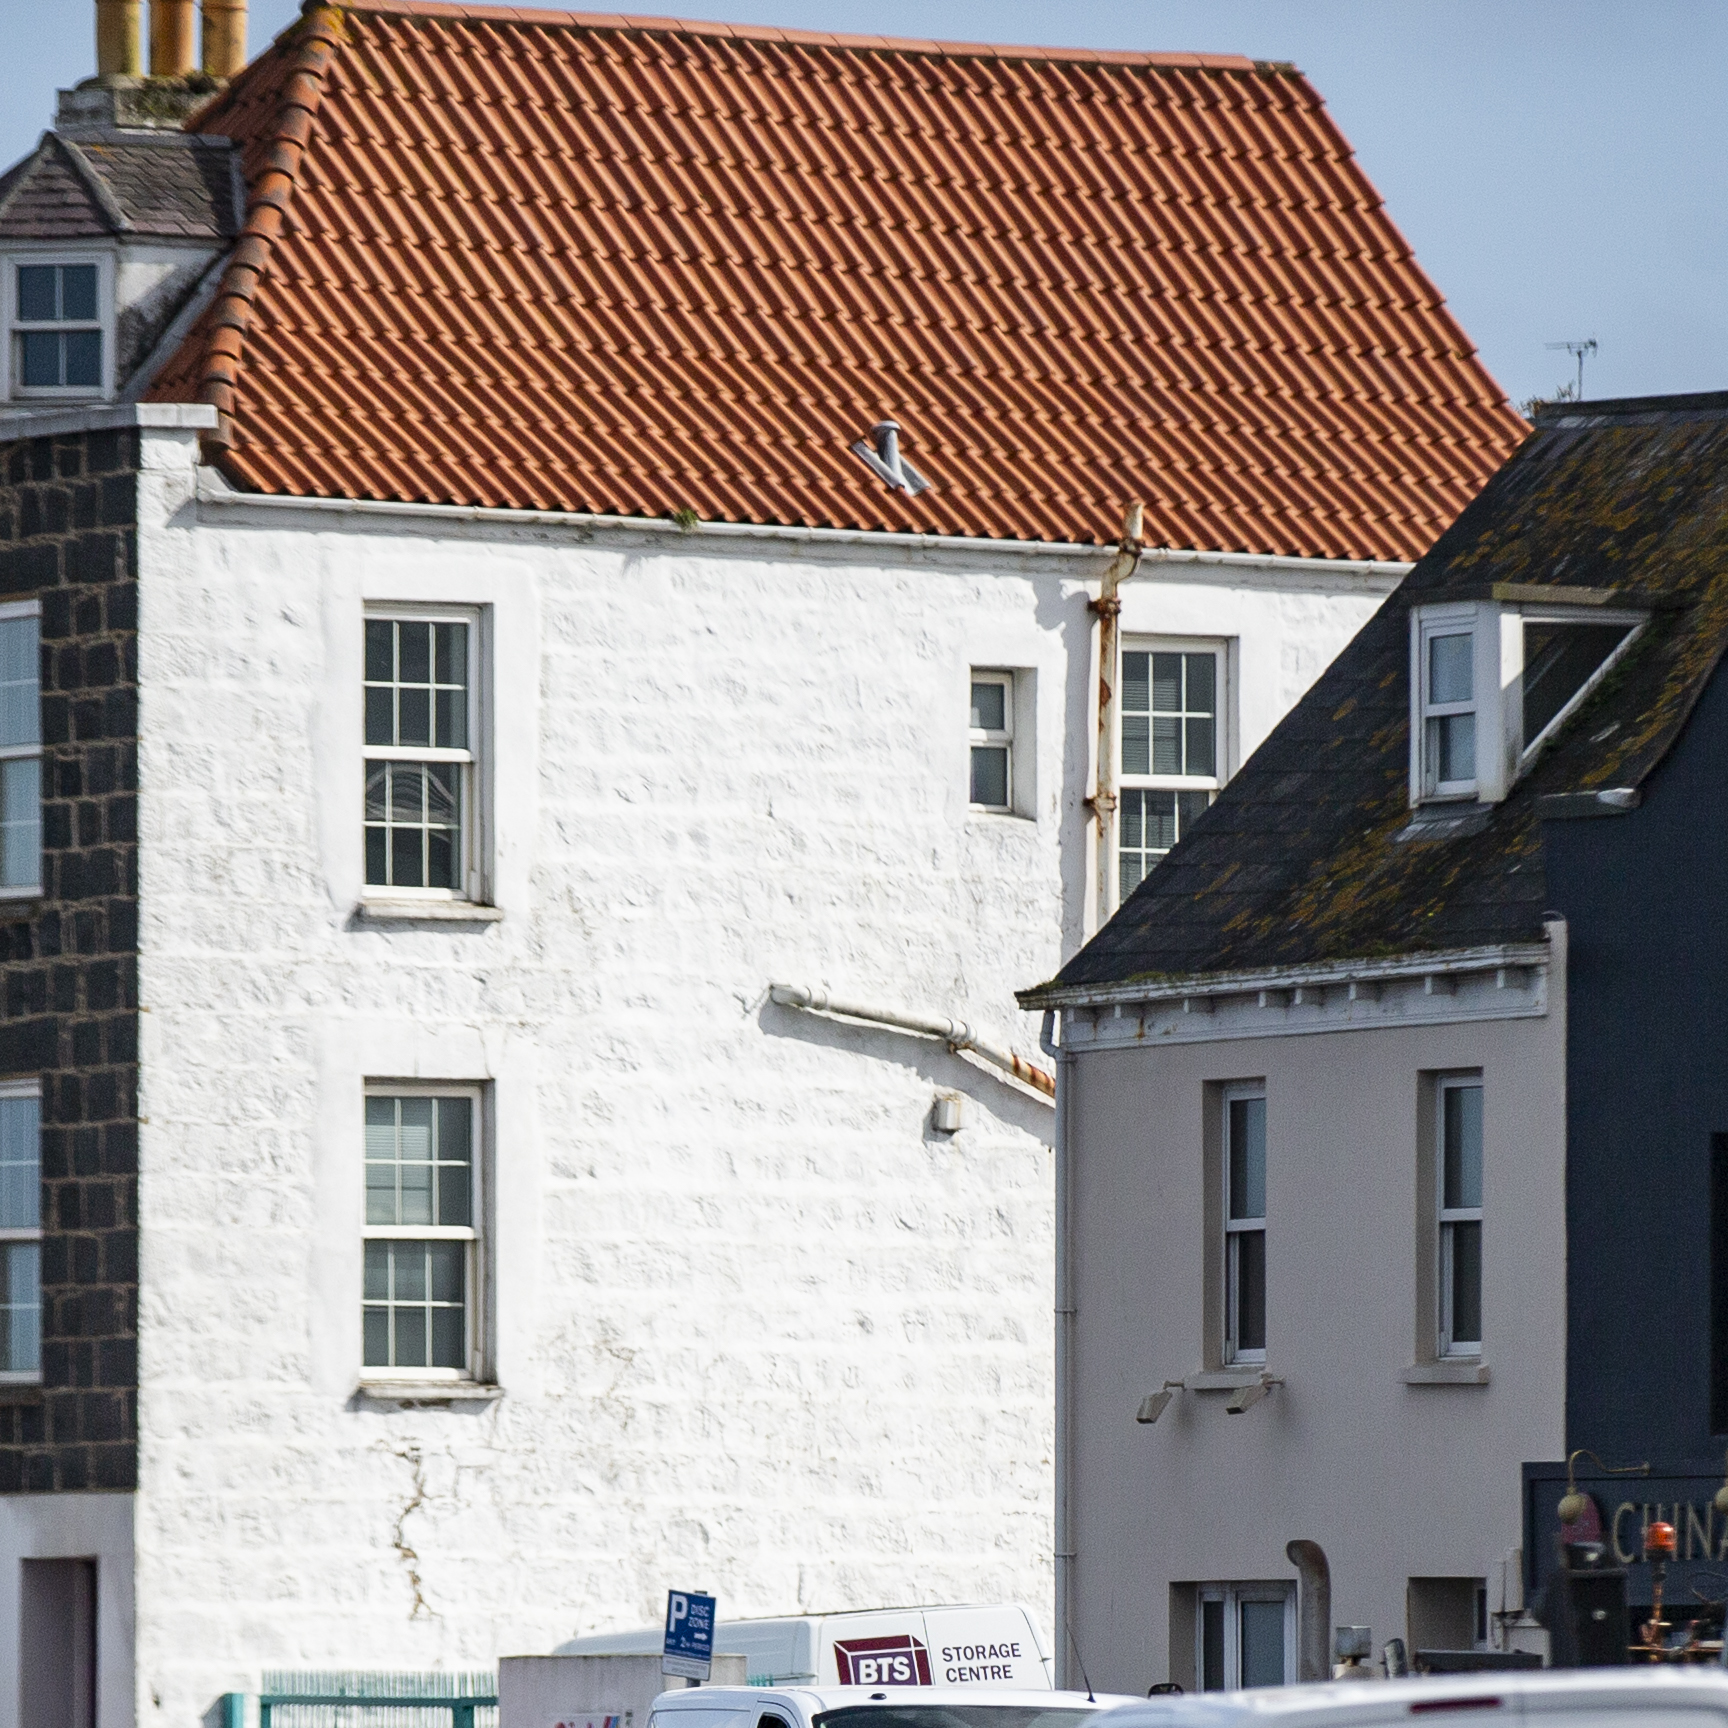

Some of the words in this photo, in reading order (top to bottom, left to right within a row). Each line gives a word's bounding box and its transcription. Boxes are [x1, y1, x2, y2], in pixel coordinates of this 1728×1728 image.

[859, 1656, 912, 1684] BTS
[941, 1642, 1022, 1663] STORAGE
[945, 1664, 1014, 1683] CENTRE
